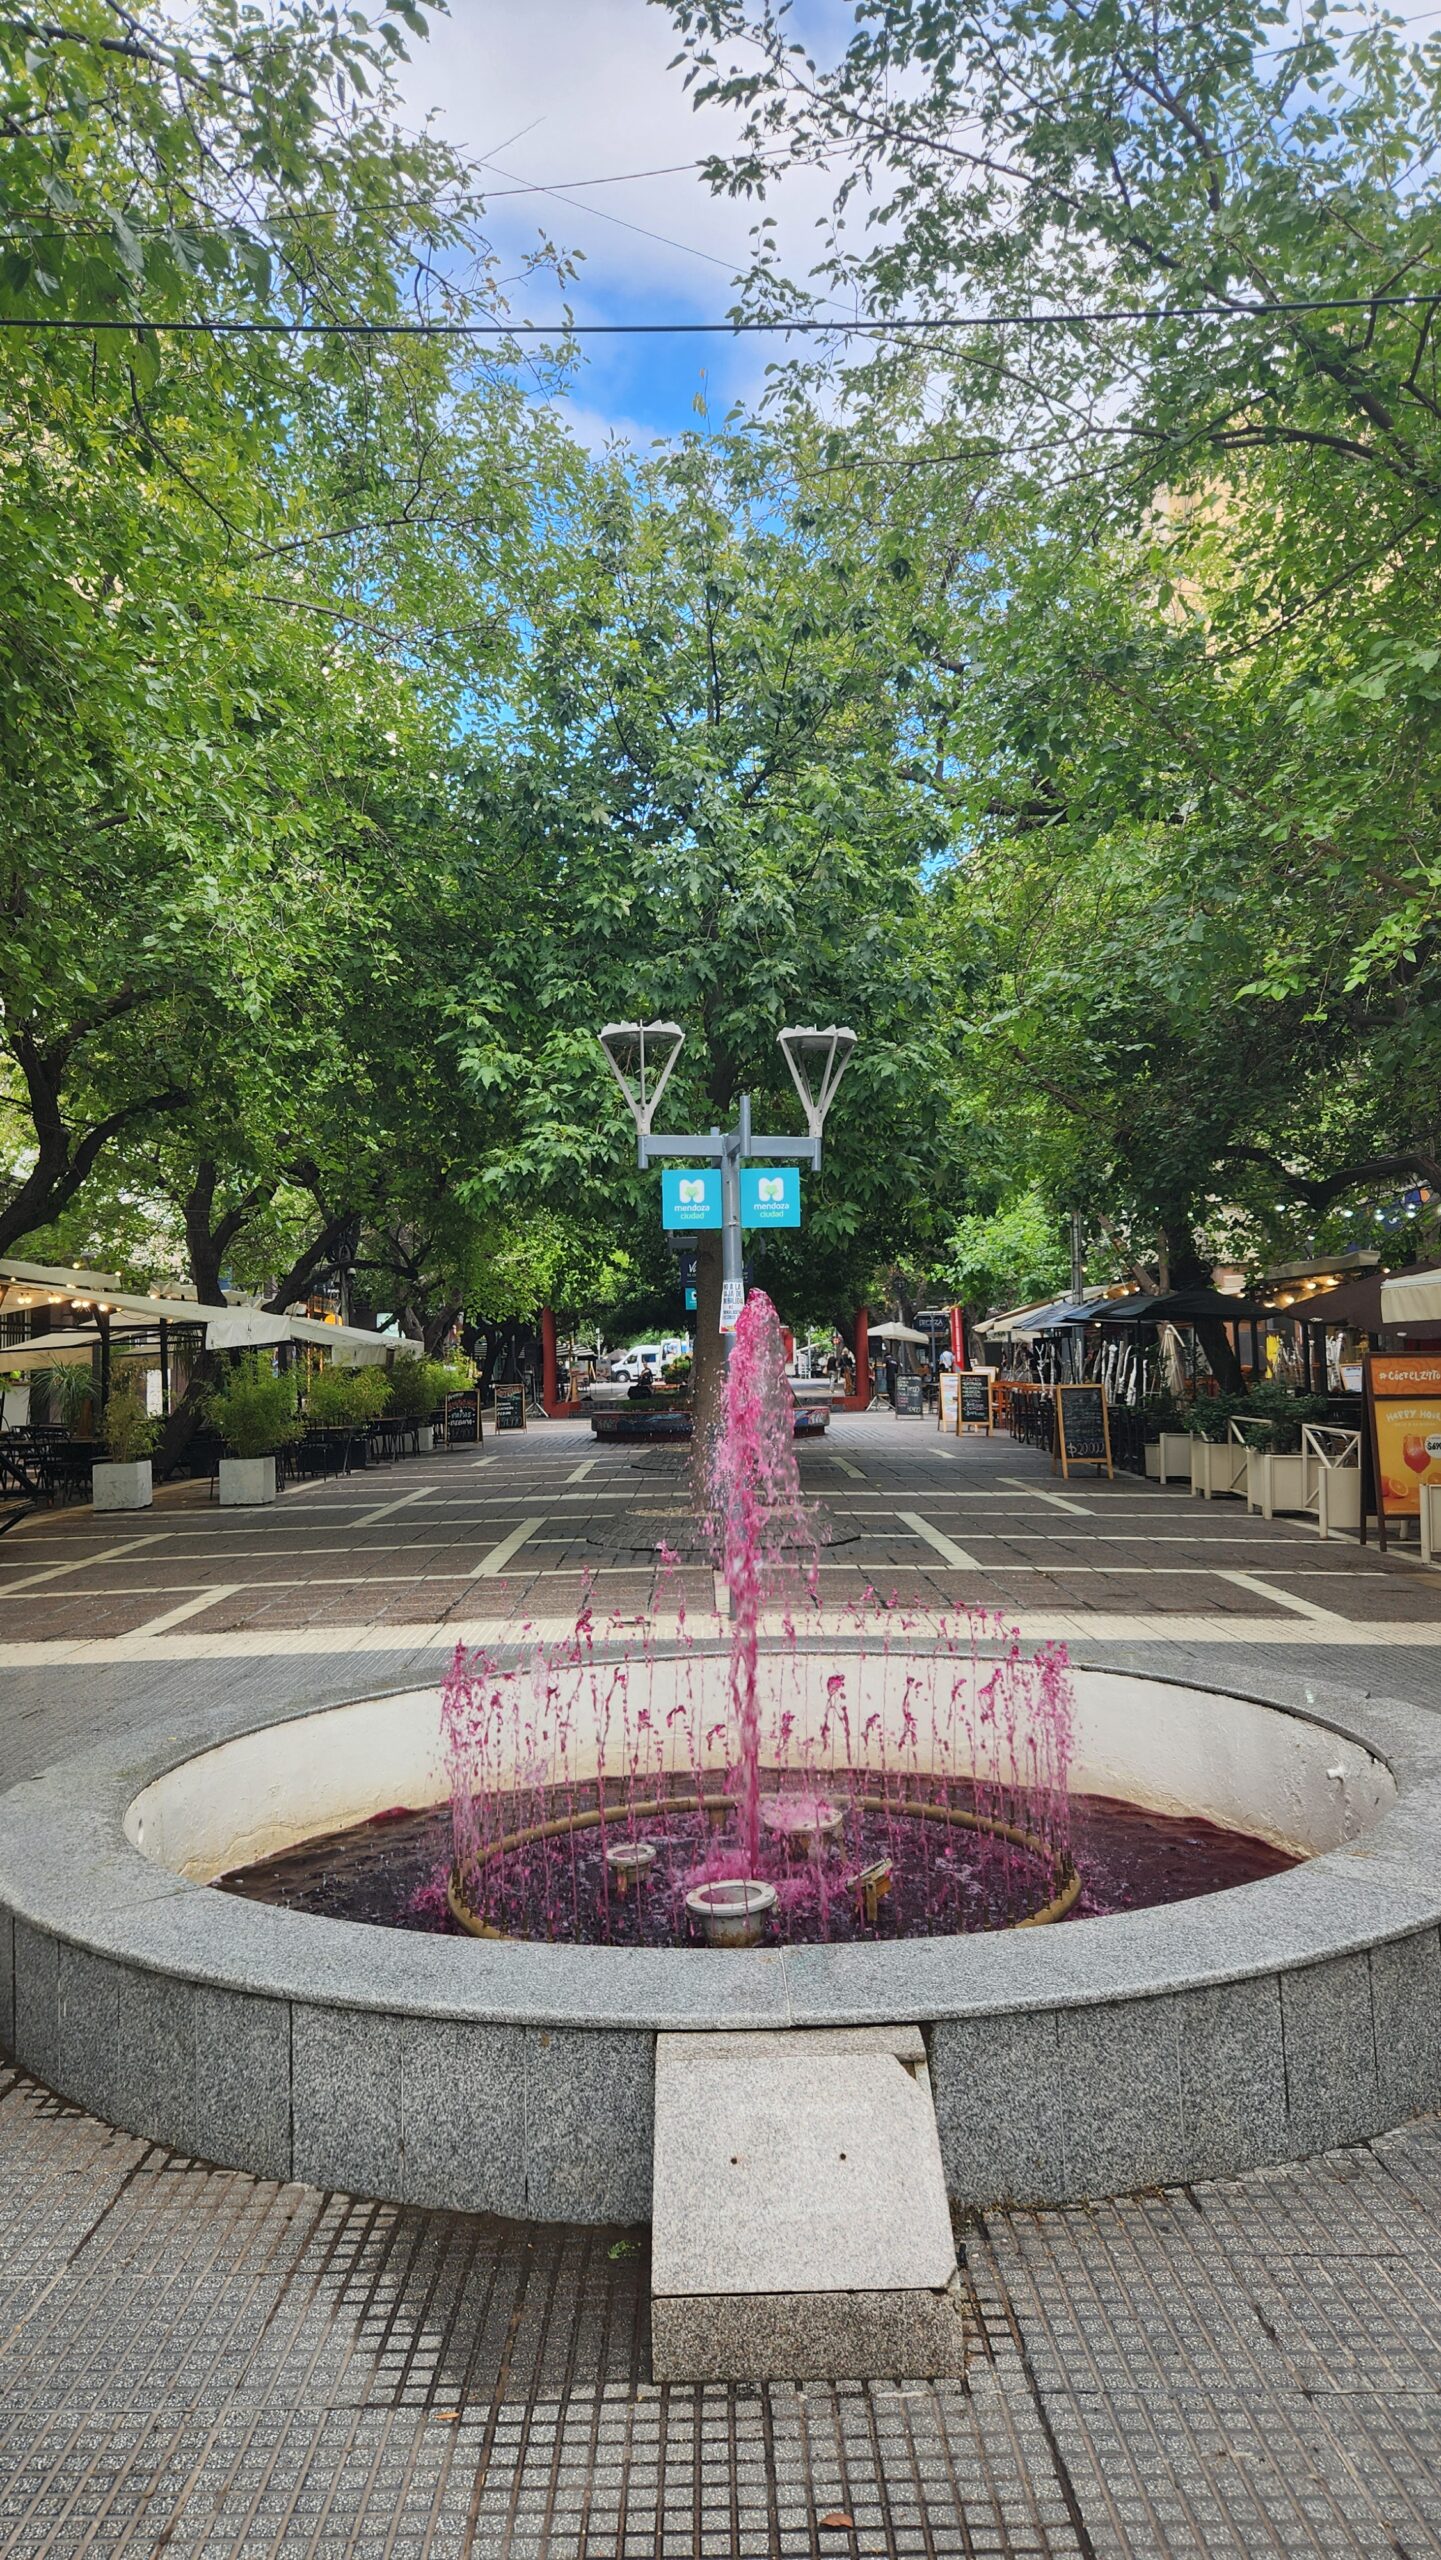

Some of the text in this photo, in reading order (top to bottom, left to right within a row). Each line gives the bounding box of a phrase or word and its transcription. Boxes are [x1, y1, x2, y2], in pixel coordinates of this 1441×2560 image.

[674, 1204, 710, 1212] mendoza
[753, 1202, 789, 1210] mendoza
[680, 1211, 705, 1219] ciudad
[759, 1210, 784, 1218] ciudad
